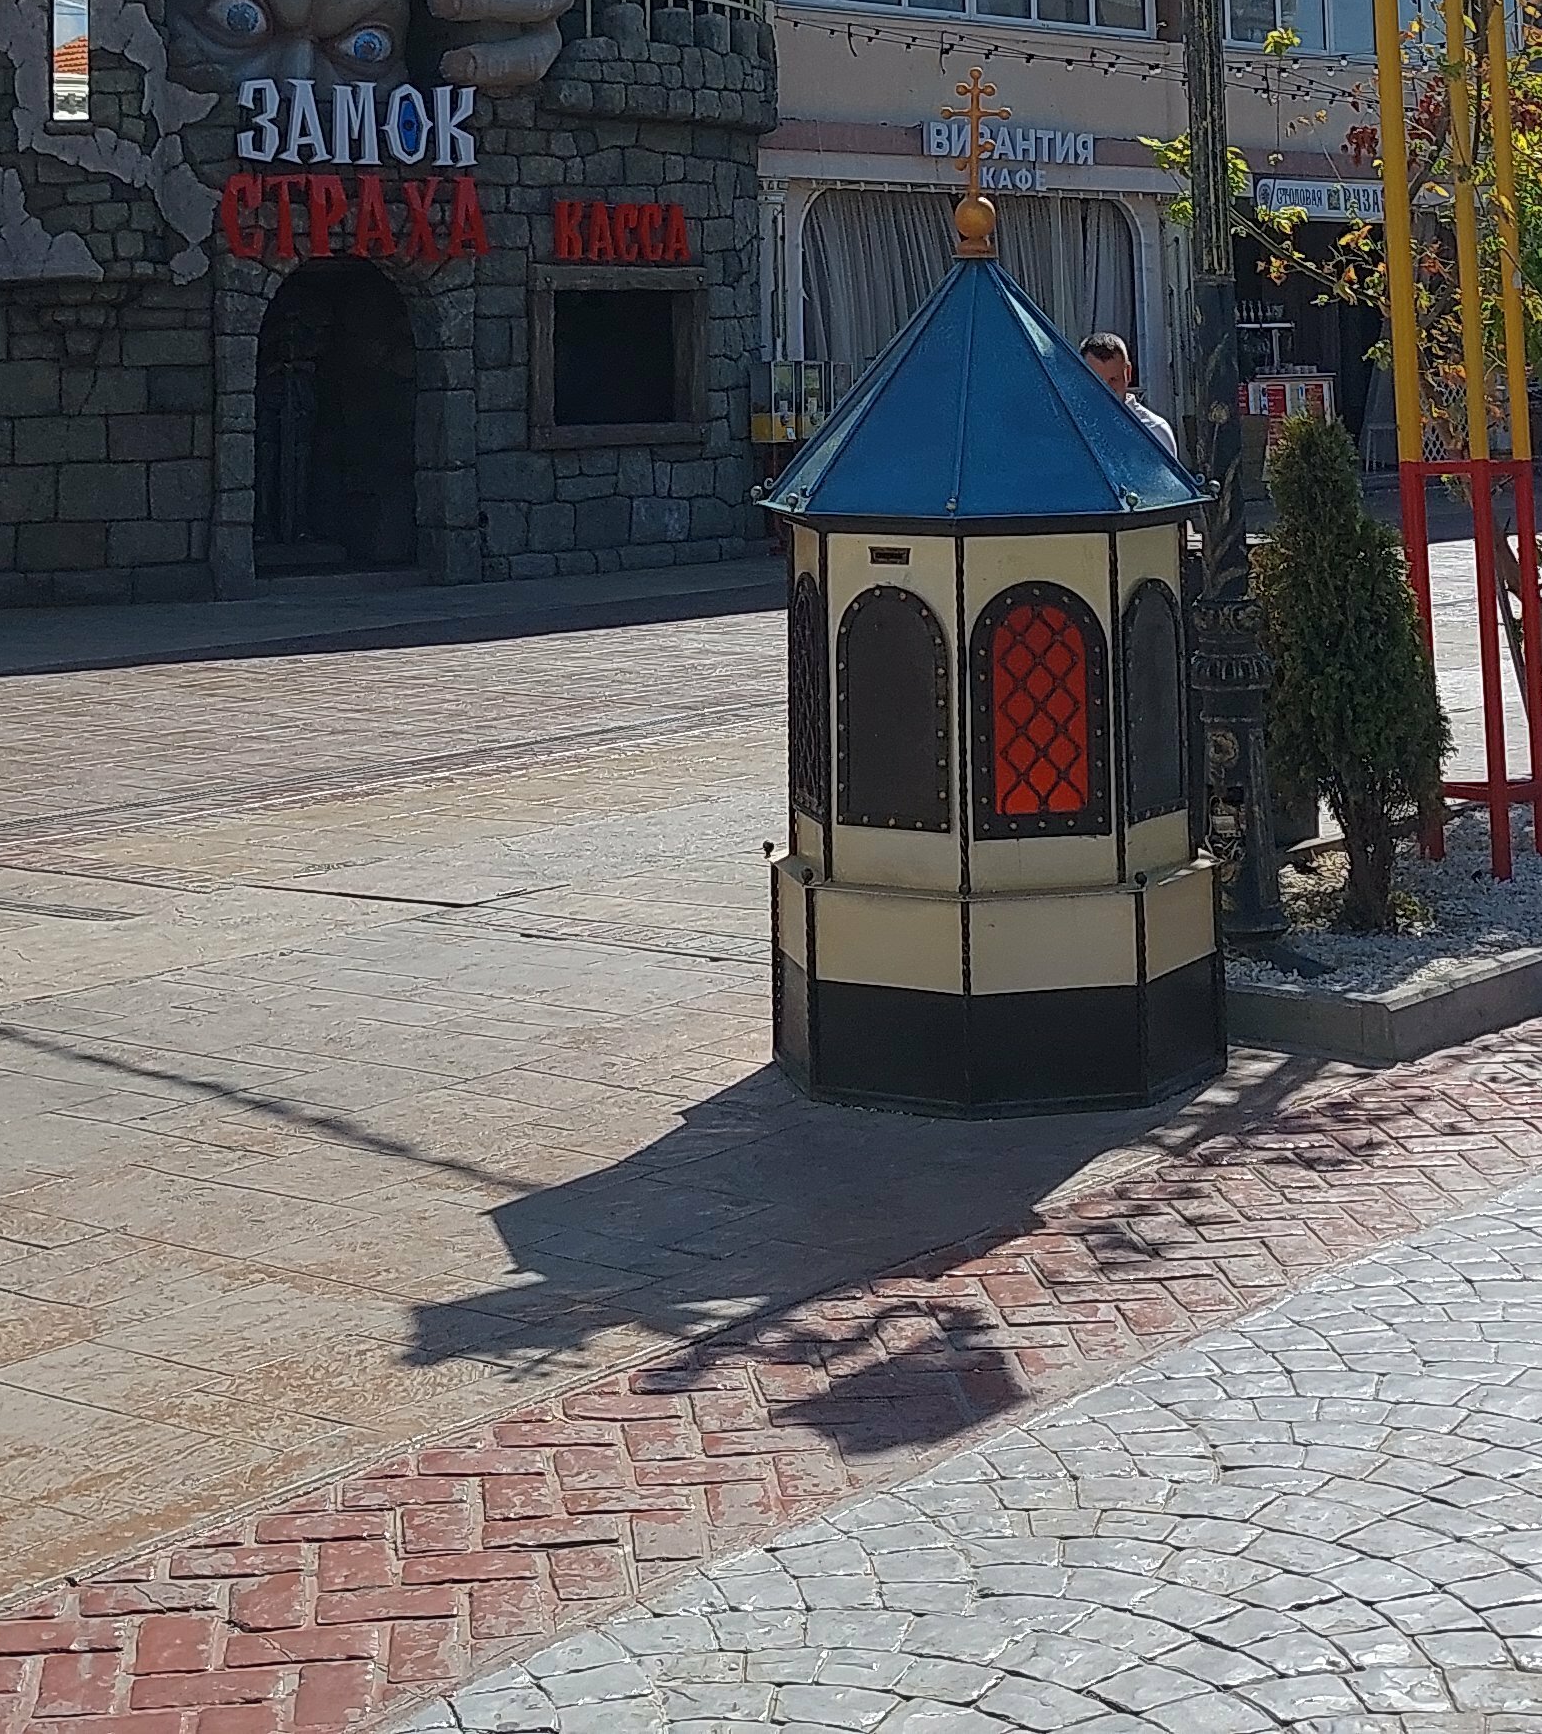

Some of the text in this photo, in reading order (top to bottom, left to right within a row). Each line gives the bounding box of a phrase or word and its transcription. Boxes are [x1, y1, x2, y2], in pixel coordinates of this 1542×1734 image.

[236, 77, 479, 168] ЗАМОК
[929, 121, 1095, 166] ВИЗАНТИЯ
[979, 166, 1047, 192] КАФЕ
[1276, 186, 1385, 213] СТОЛОВАЯ ВИЗА
[220, 173, 490, 261] СТРАХА
[553, 200, 692, 262] КАССА
